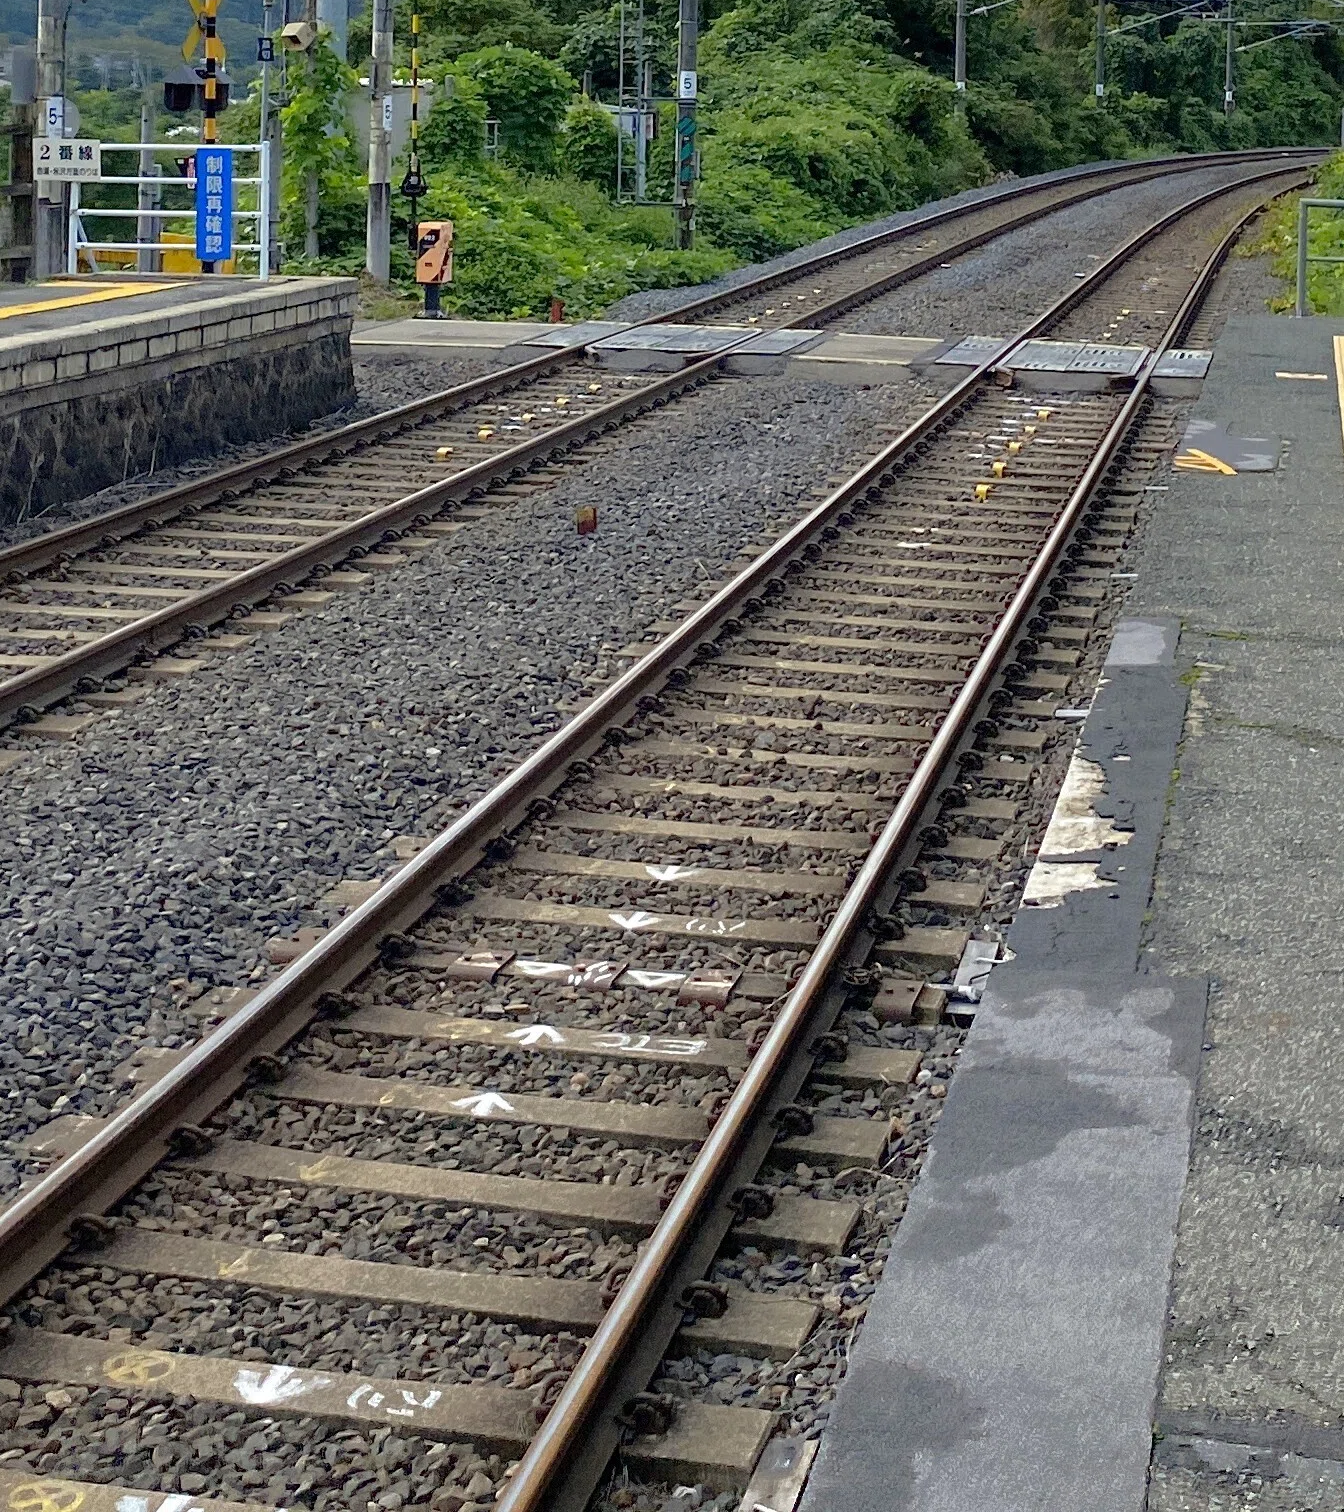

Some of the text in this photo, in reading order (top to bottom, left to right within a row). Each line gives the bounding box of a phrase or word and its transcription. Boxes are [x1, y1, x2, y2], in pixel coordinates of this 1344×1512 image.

[683, 77, 692, 90] 5
[39, 144, 93, 161] 2番線
[205, 155, 223, 254] 制限再確認
